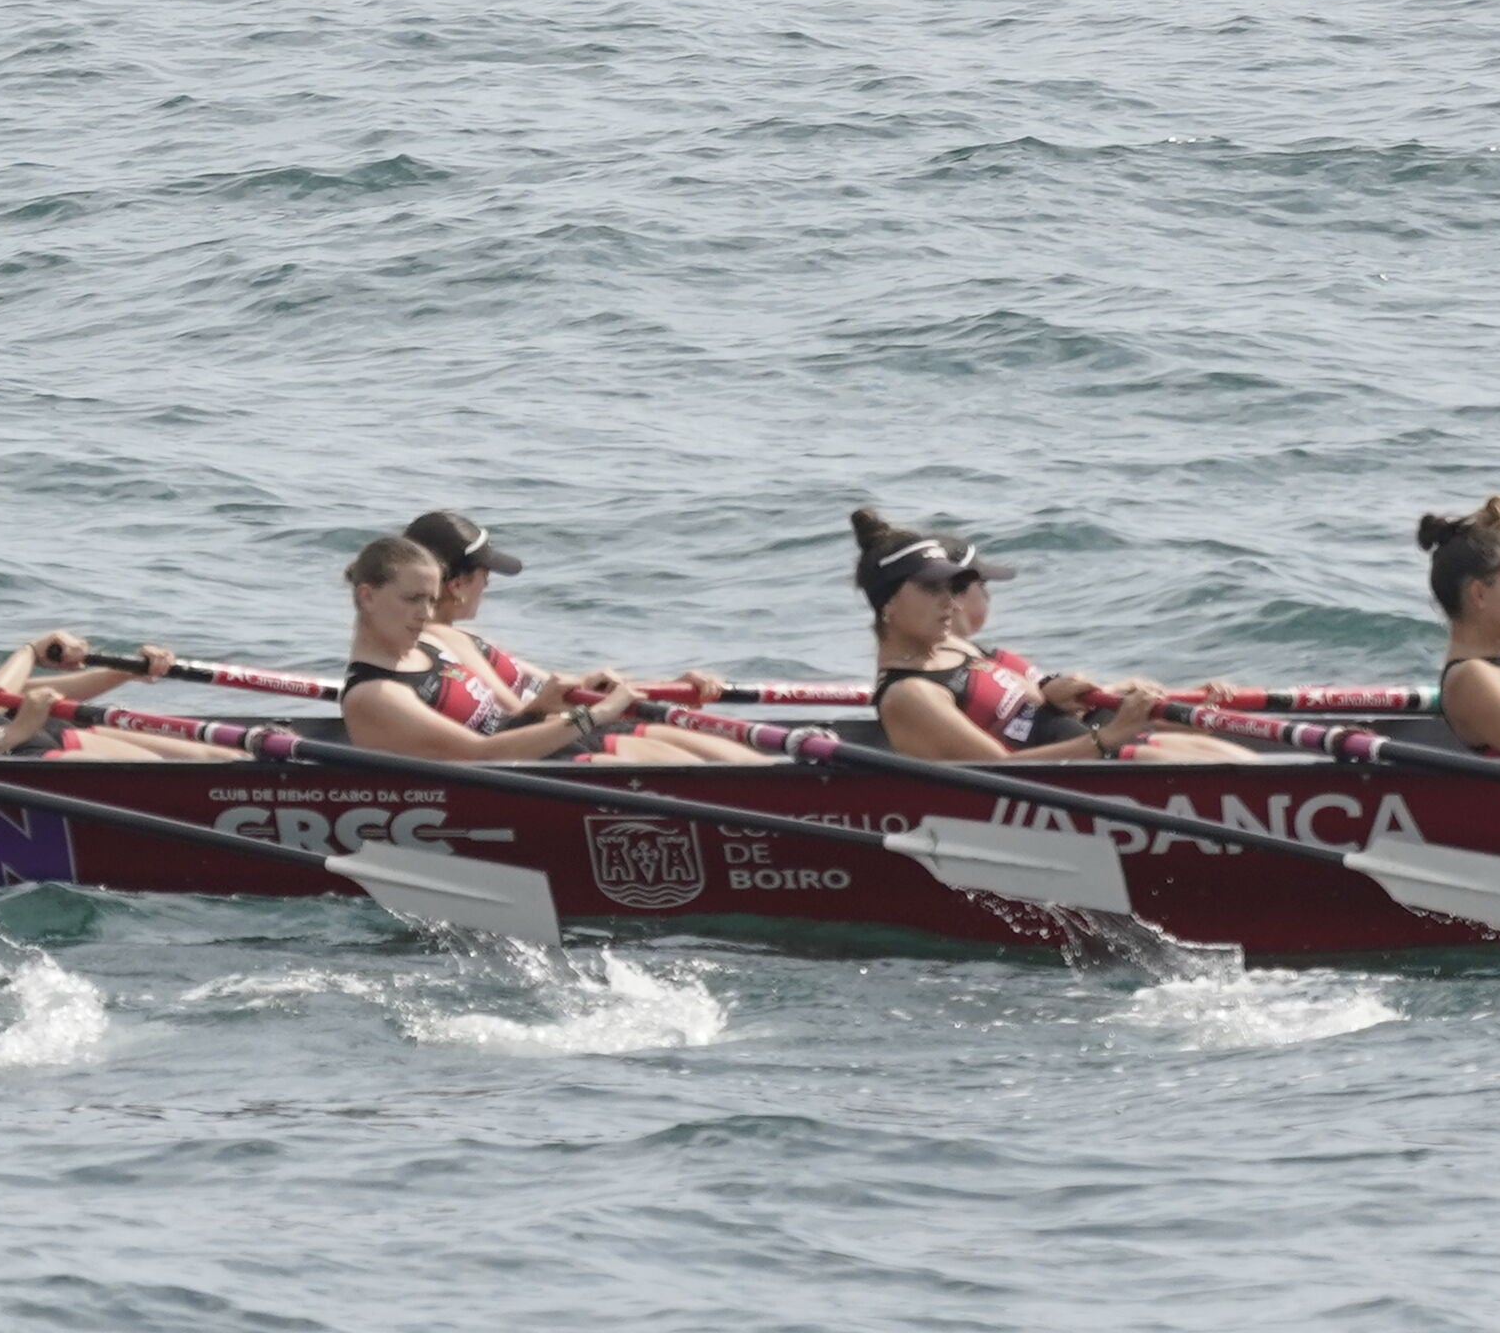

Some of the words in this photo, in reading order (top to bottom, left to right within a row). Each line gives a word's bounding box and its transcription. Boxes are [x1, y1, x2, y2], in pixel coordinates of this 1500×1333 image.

[208, 788, 248, 803] CLUB
[253, 788, 273, 802] DE
[277, 789, 323, 803] REMO
[378, 789, 399, 803] DA
[404, 789, 448, 804] CRUZ
[722, 843, 773, 865] DE
[729, 869, 851, 890] BOIRO
